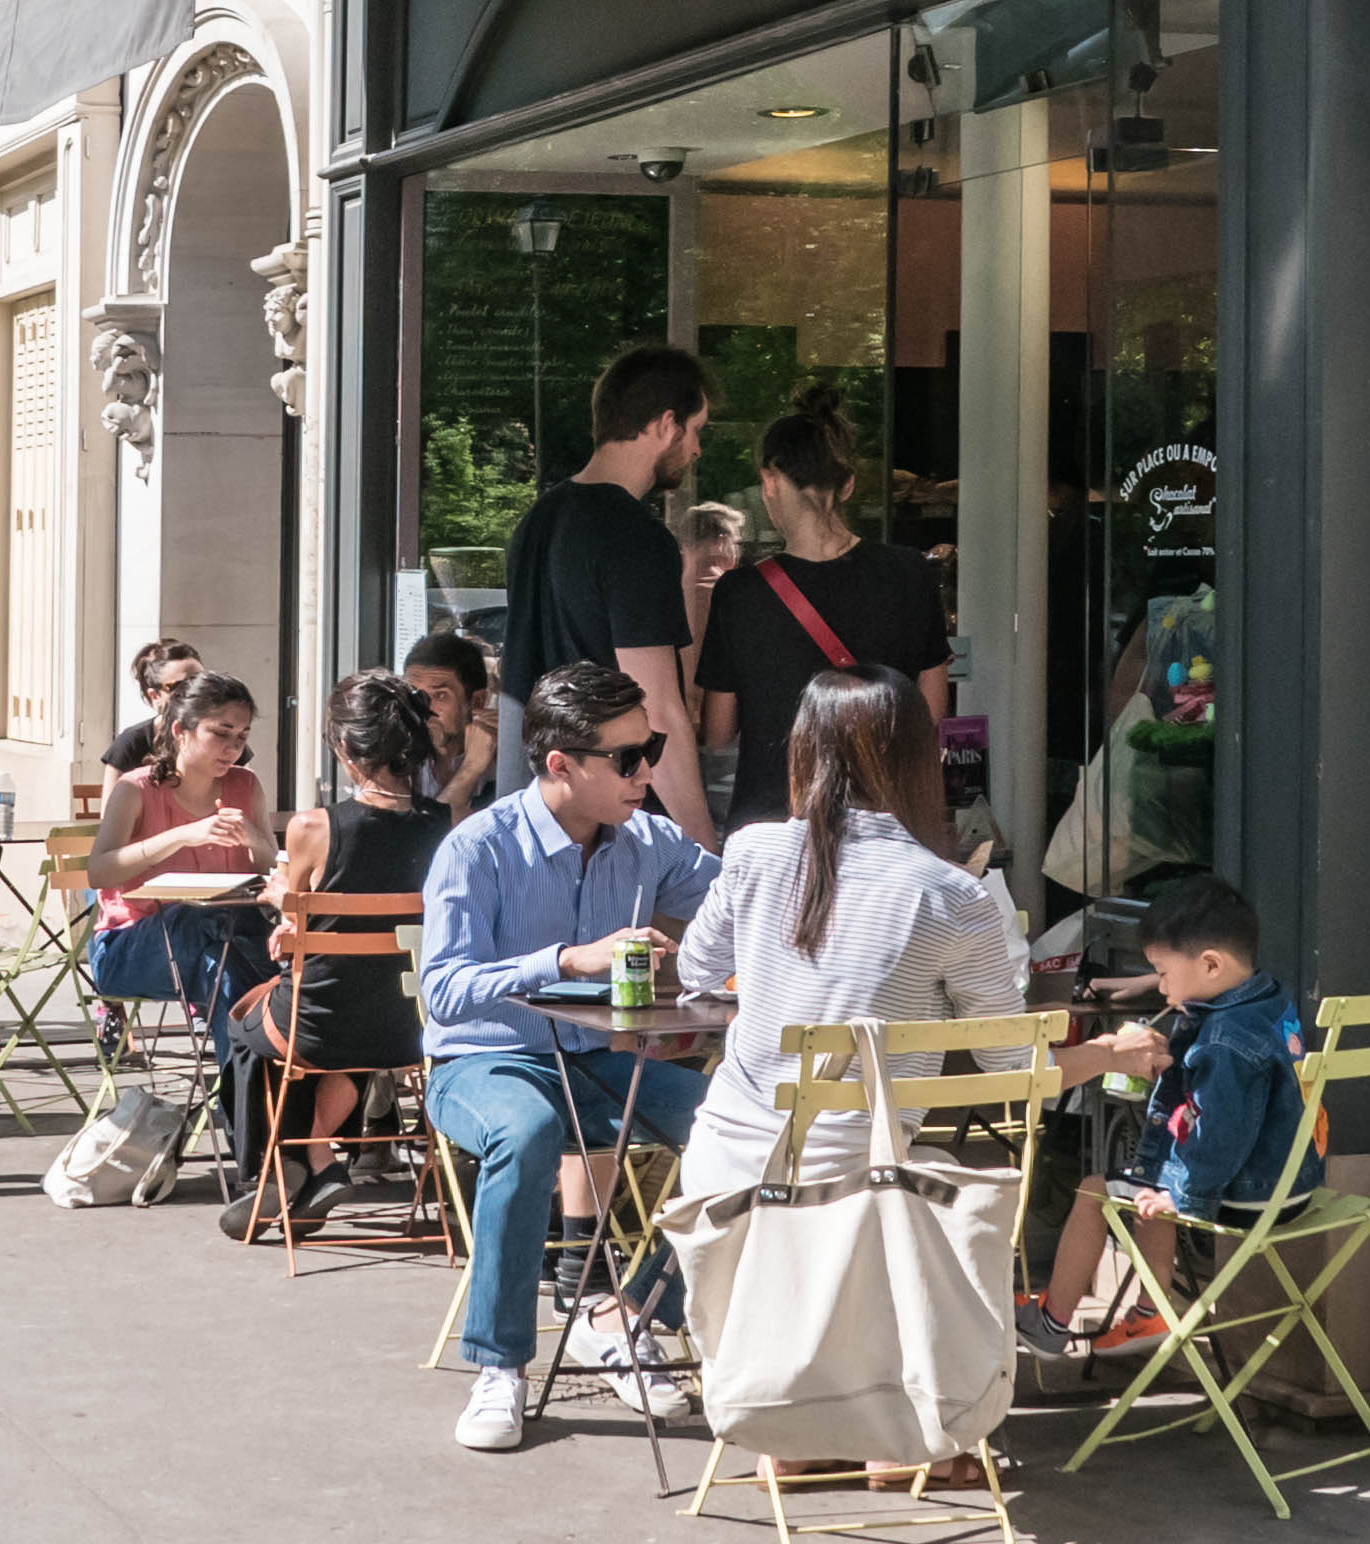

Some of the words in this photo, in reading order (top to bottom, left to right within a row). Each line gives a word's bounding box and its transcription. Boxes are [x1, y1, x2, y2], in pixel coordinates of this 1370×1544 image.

[1119, 470, 1139, 502] SUR
[1136, 447, 1165, 478] PLACE
[1166, 443, 1181, 462] OU
[1182, 443, 1190, 461] A
